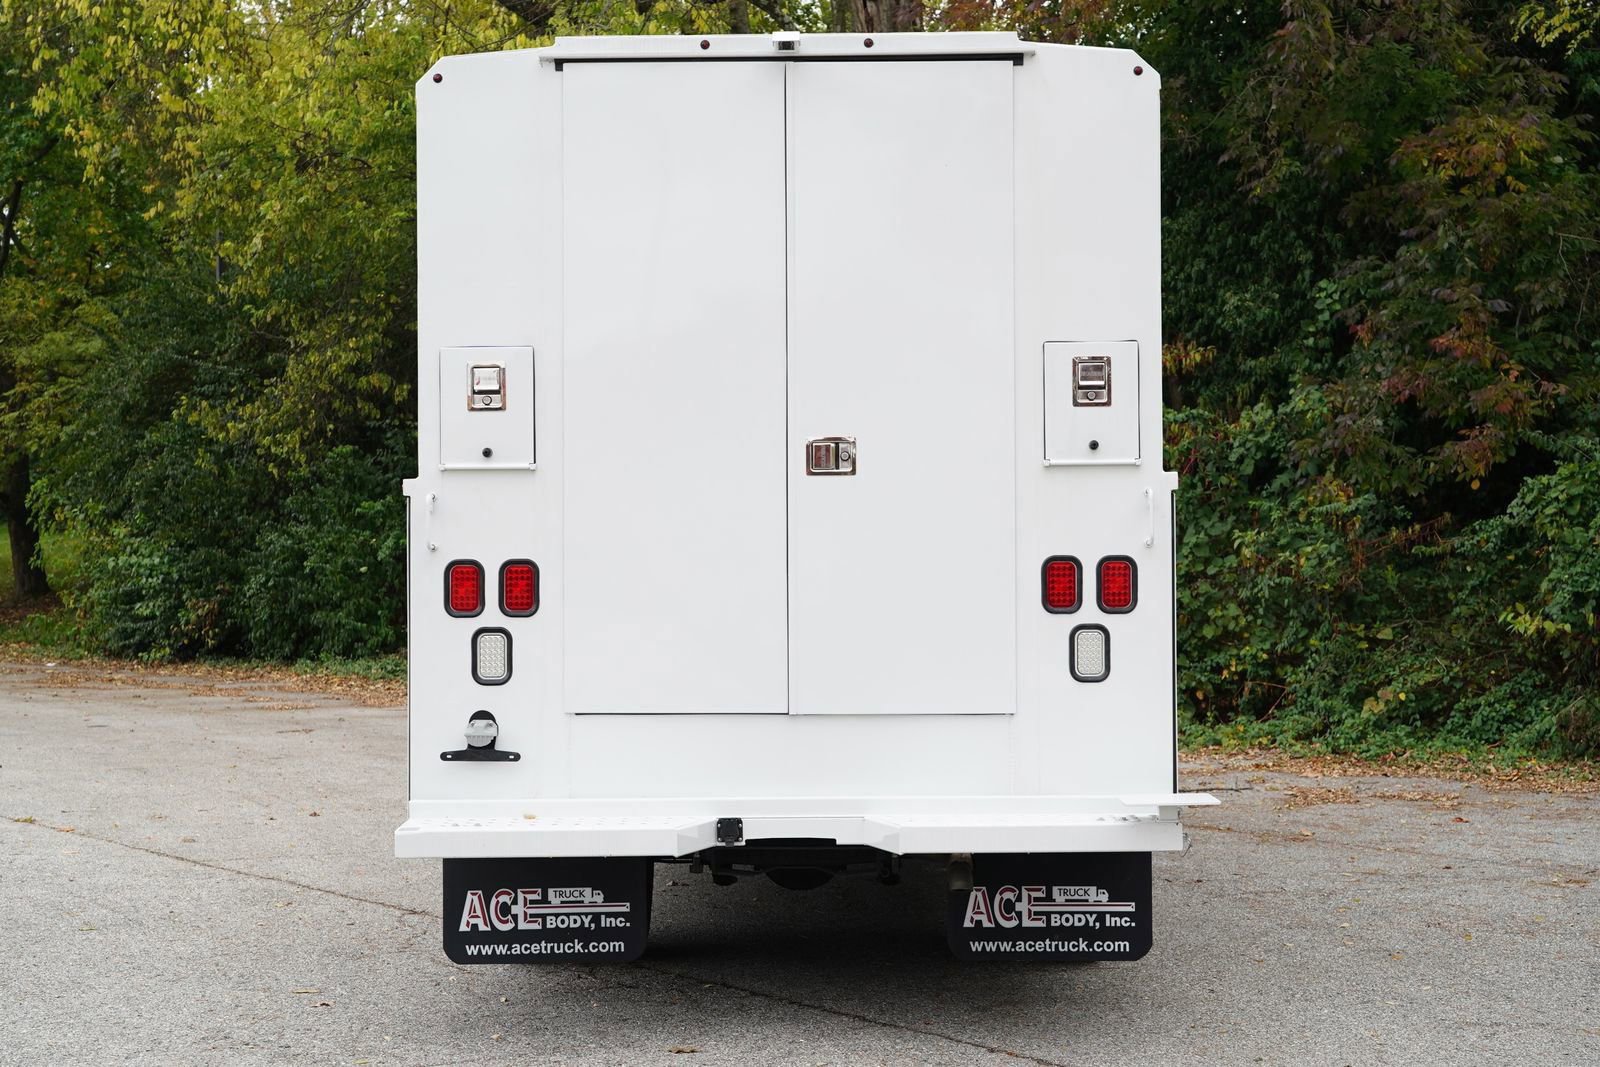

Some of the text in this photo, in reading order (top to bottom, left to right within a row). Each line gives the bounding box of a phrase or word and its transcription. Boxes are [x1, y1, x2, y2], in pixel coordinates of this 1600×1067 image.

[552, 889, 587, 899] TRUCK
[1057, 887, 1091, 897] TRUCK
[458, 888, 542, 932] ACE
[963, 885, 1046, 928] ACE
[546, 914, 631, 931] BODY, Inc.
[1050, 913, 1136, 929] BODY, Inc.
[465, 938, 625, 955] www.acetruck.com
[969, 937, 1130, 953] www.acetruck.com
